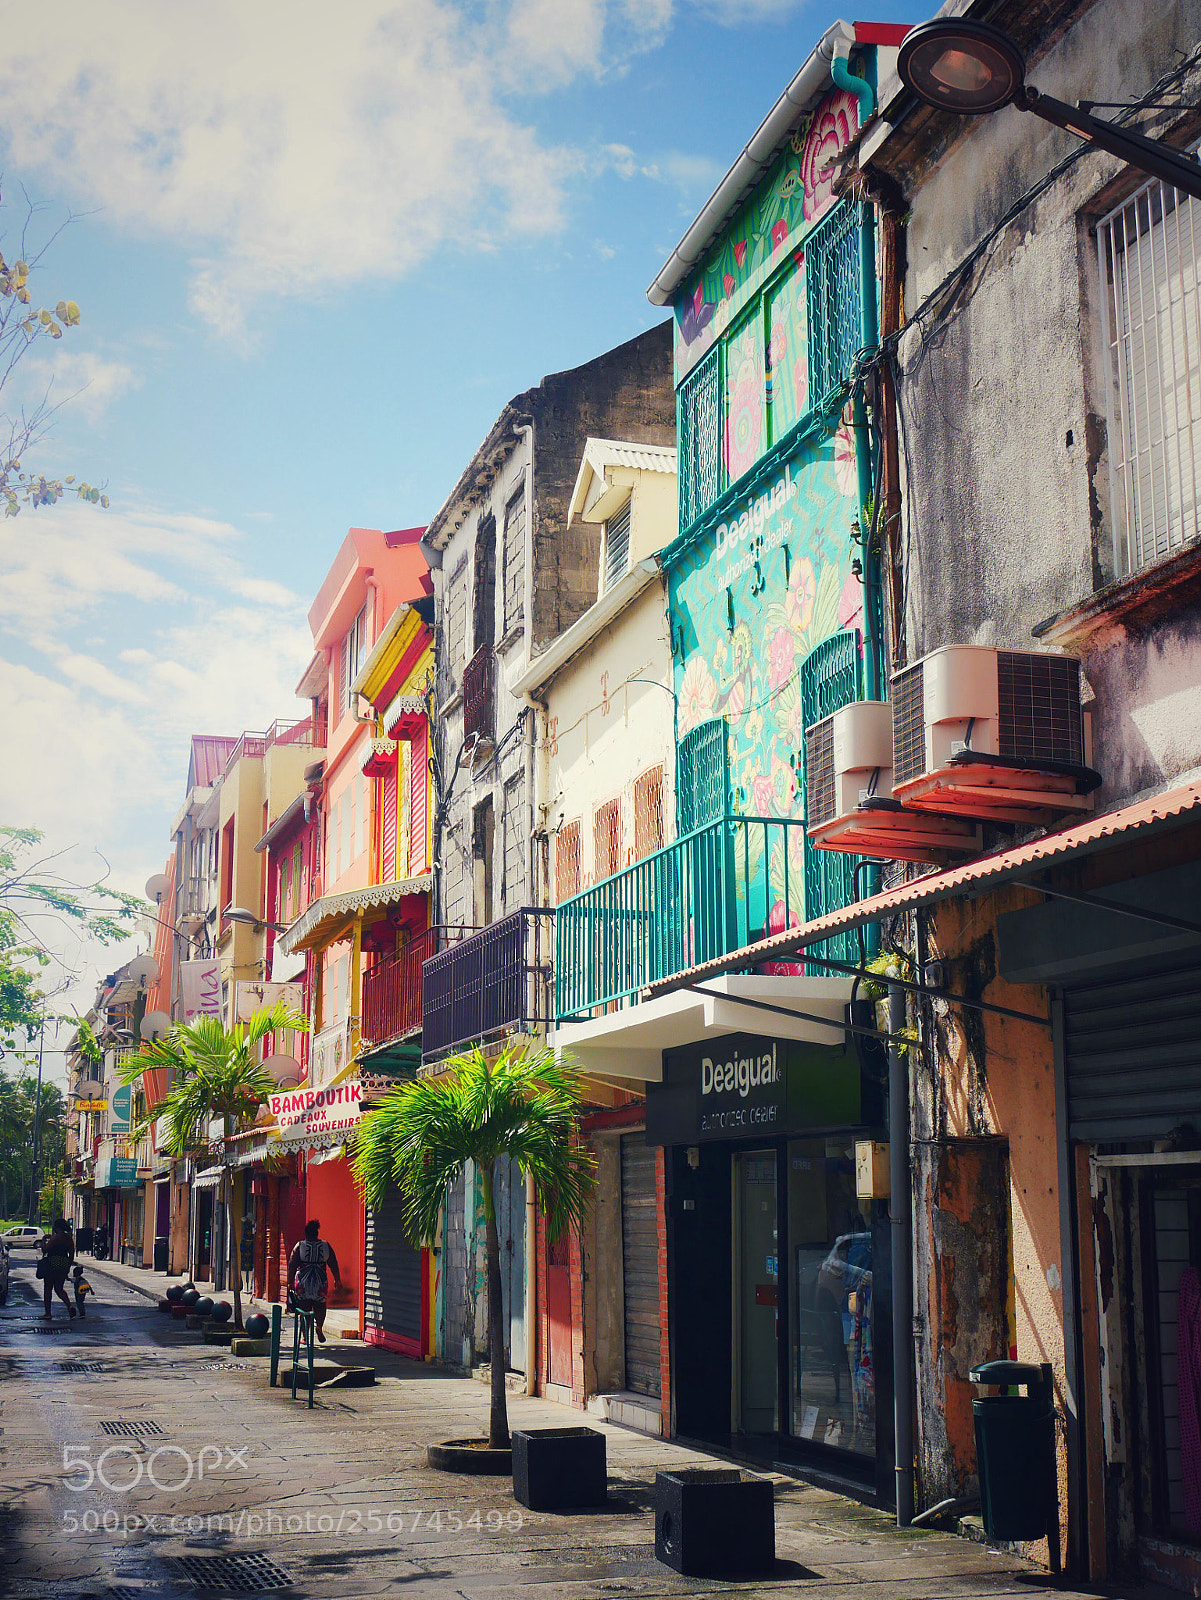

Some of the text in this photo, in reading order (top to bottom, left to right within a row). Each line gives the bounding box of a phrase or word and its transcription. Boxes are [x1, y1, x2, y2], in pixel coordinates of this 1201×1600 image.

[716, 464, 791, 561] Desigual
[764, 517, 793, 552] dealer
[702, 1043, 777, 1097] Desigual
[271, 1085, 362, 1114] BAMBOUTIK
[281, 1110, 326, 1126] CADEAUX
[306, 1117, 360, 1134] SOUVENIRS
